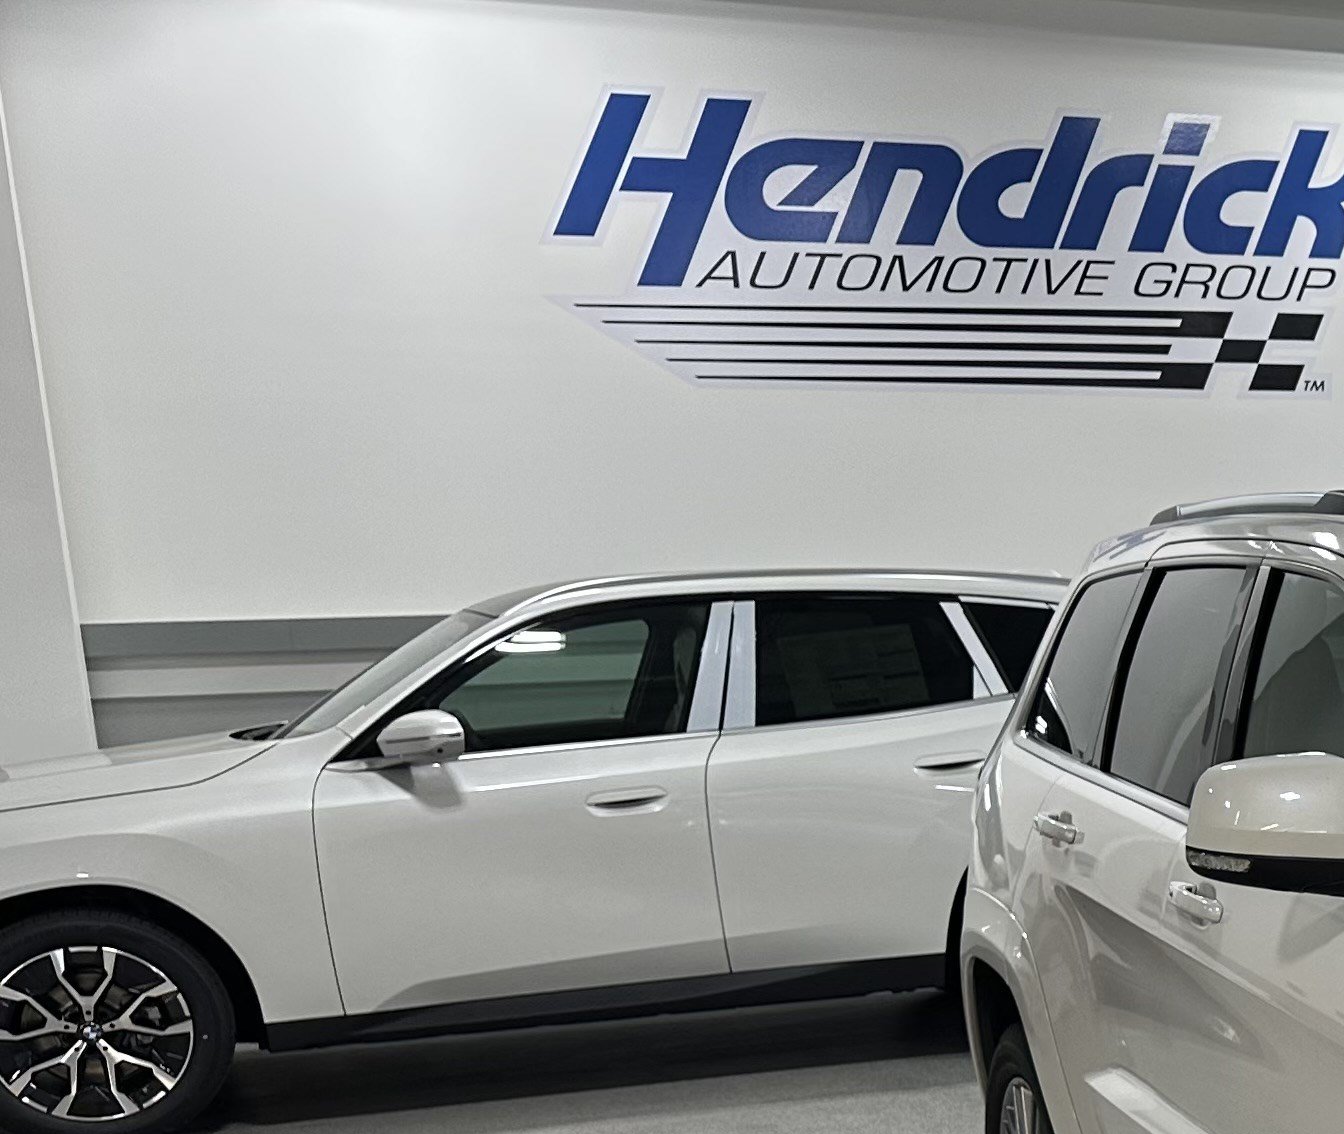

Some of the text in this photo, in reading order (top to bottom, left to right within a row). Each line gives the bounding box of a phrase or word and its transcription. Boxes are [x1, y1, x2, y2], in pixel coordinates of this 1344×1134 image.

[696, 250, 1338, 303] AUTOMOTIVE GROUP
[1304, 380, 1325, 391] TM
